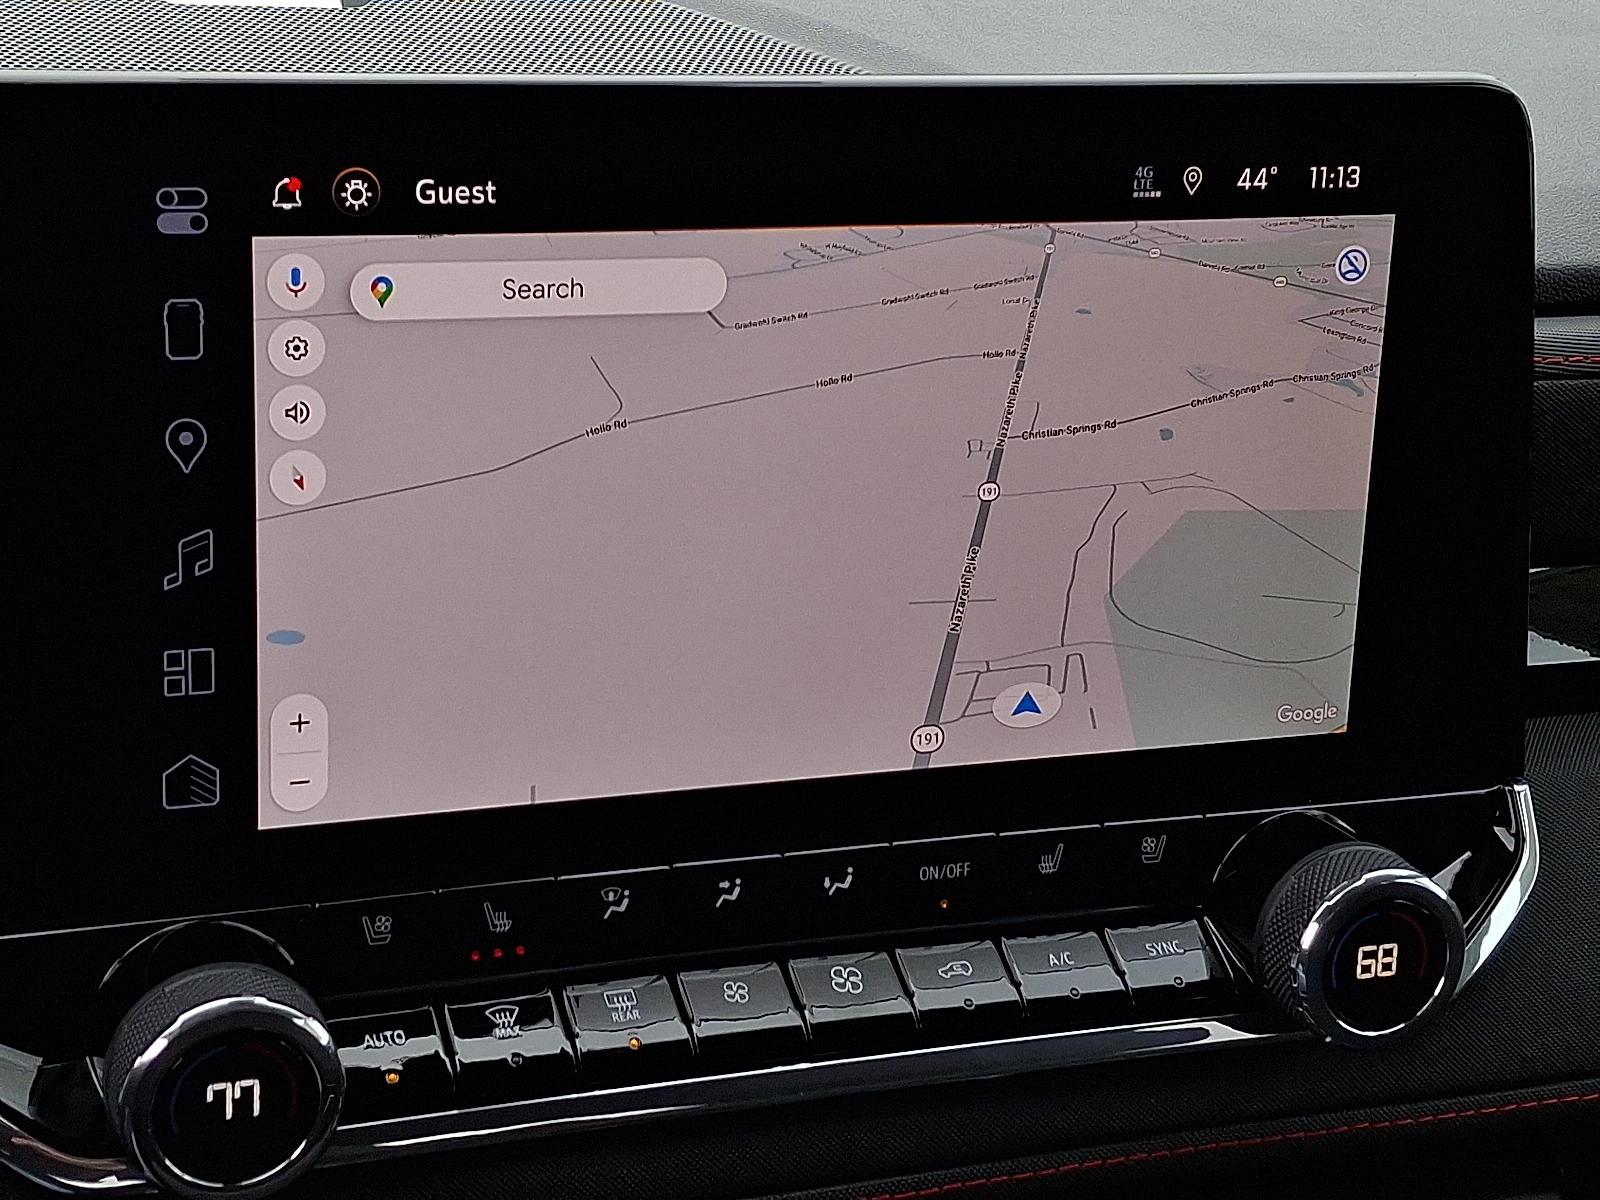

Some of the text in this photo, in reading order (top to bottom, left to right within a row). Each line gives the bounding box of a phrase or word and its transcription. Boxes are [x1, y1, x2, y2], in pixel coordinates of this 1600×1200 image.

[1134, 166, 1154, 178] 4G
[1309, 165, 1361, 189] 11:13
[415, 179, 497, 204] Guest
[1133, 178, 1154, 190] LTE
[502, 277, 585, 300] Search
[1005, 348, 1017, 357] Rd
[840, 373, 853, 383] Rd
[1292, 363, 1374, 383] Christian Springs Rd
[1190, 379, 1274, 408] Christian Springs Rd
[996, 371, 1023, 448] Nazareth Pike
[585, 419, 628, 438] Hollo Rd
[1021, 419, 1117, 441] Christian Springs Rd
[981, 487, 997, 497] 191
[949, 547, 980, 633] Nazareth Pike
[1276, 702, 1338, 724] Google
[916, 731, 941, 747] 191
[919, 861, 971, 881] ON/OFF
[1145, 940, 1185, 957] SYNC
[1049, 951, 1075, 967] A/C
[1356, 943, 1398, 980] 68
[611, 1009, 641, 1023] REAR
[362, 1030, 407, 1049] AUTO
[495, 1025, 522, 1038] MAX
[206, 1078, 260, 1120] 77
